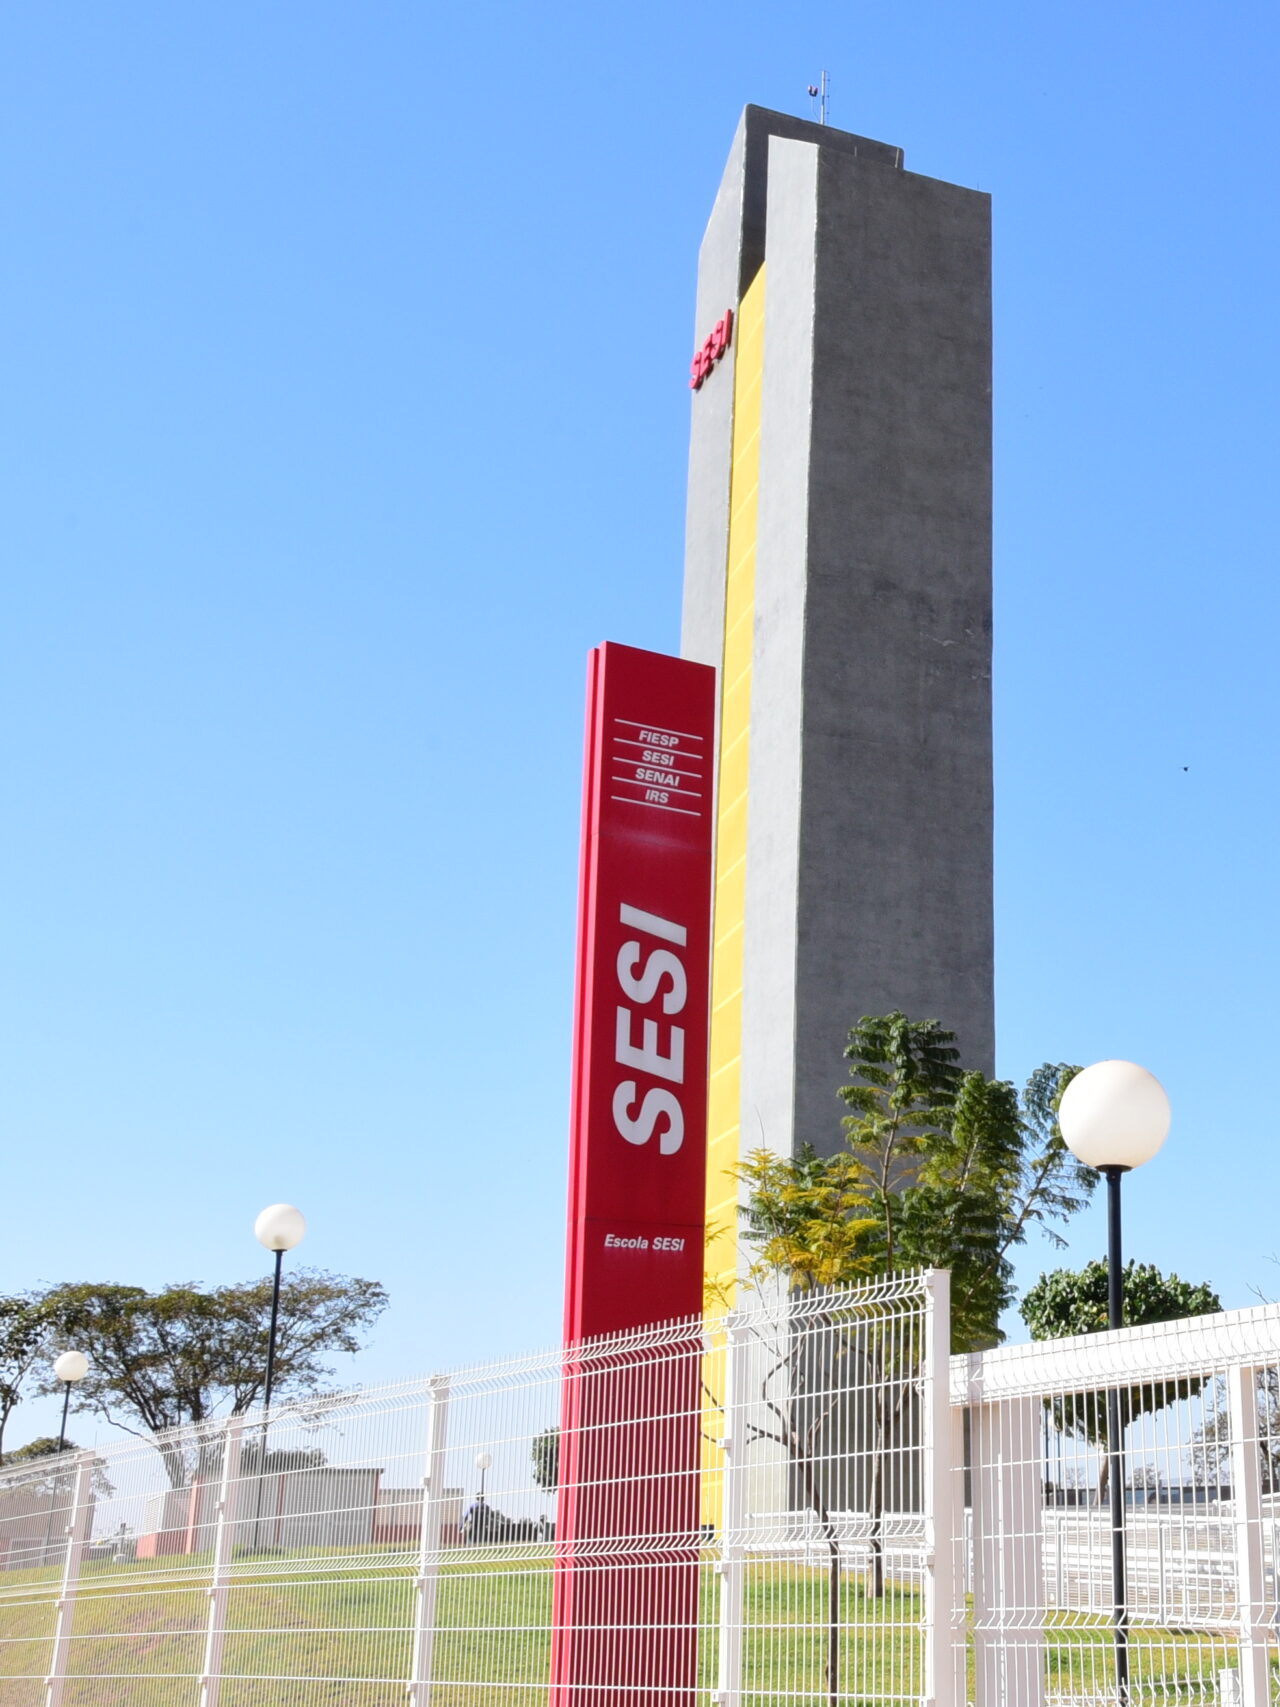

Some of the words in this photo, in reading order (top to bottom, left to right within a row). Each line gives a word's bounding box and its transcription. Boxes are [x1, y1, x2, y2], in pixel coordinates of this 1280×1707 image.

[688, 308, 733, 391] SESI
[639, 730, 679, 747] FIESP
[642, 750, 674, 766] SESI
[635, 768, 680, 787] SENAI
[645, 789, 669, 804] IRS
[612, 902, 688, 1155] SESI
[604, 1233, 649, 1249] Escola
[652, 1237, 685, 1251] SESI
